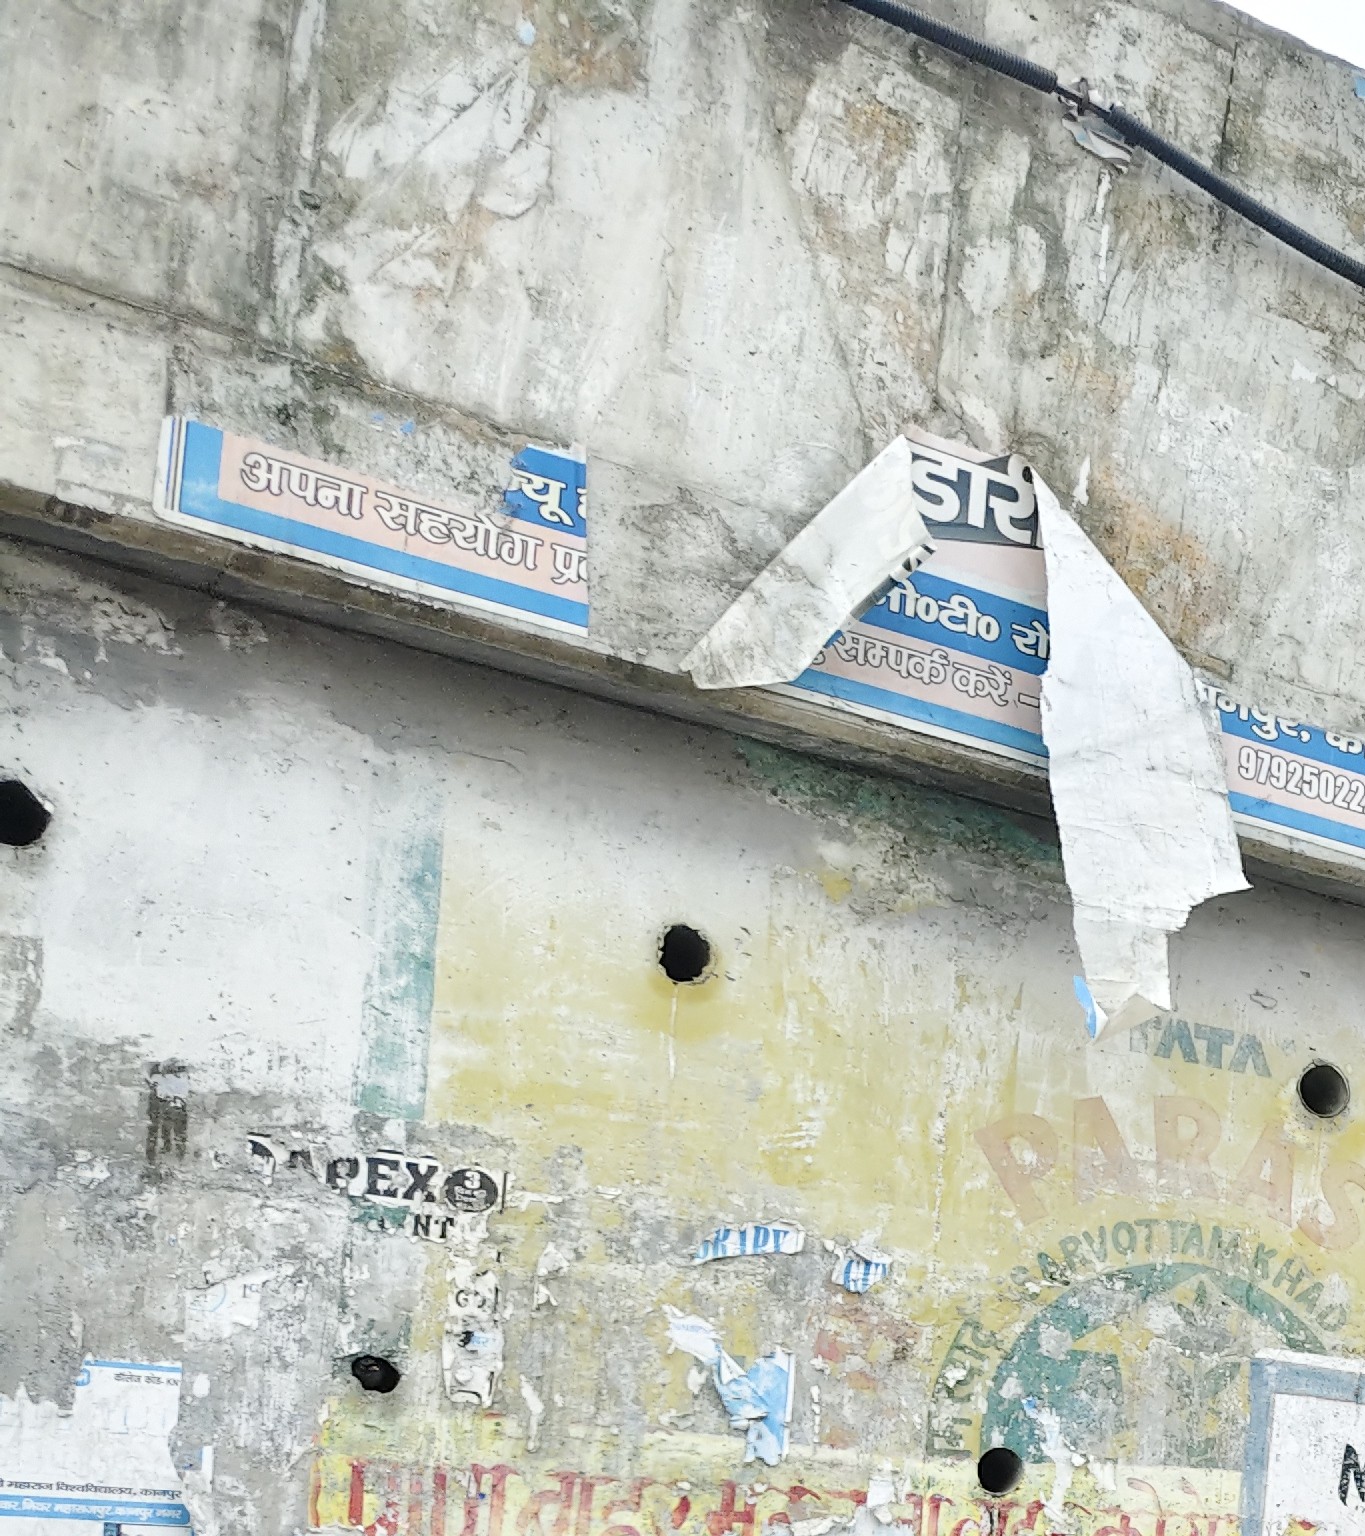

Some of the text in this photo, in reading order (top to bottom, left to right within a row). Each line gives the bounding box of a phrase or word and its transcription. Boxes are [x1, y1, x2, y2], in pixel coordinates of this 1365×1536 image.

[241, 451, 368, 521] अपना
[374, 490, 543, 571] सहयोग
[833, 632, 950, 686] सम्पर्क
[951, 660, 1013, 707] करें
[139, 1488, 183, 1501] कानपुर
